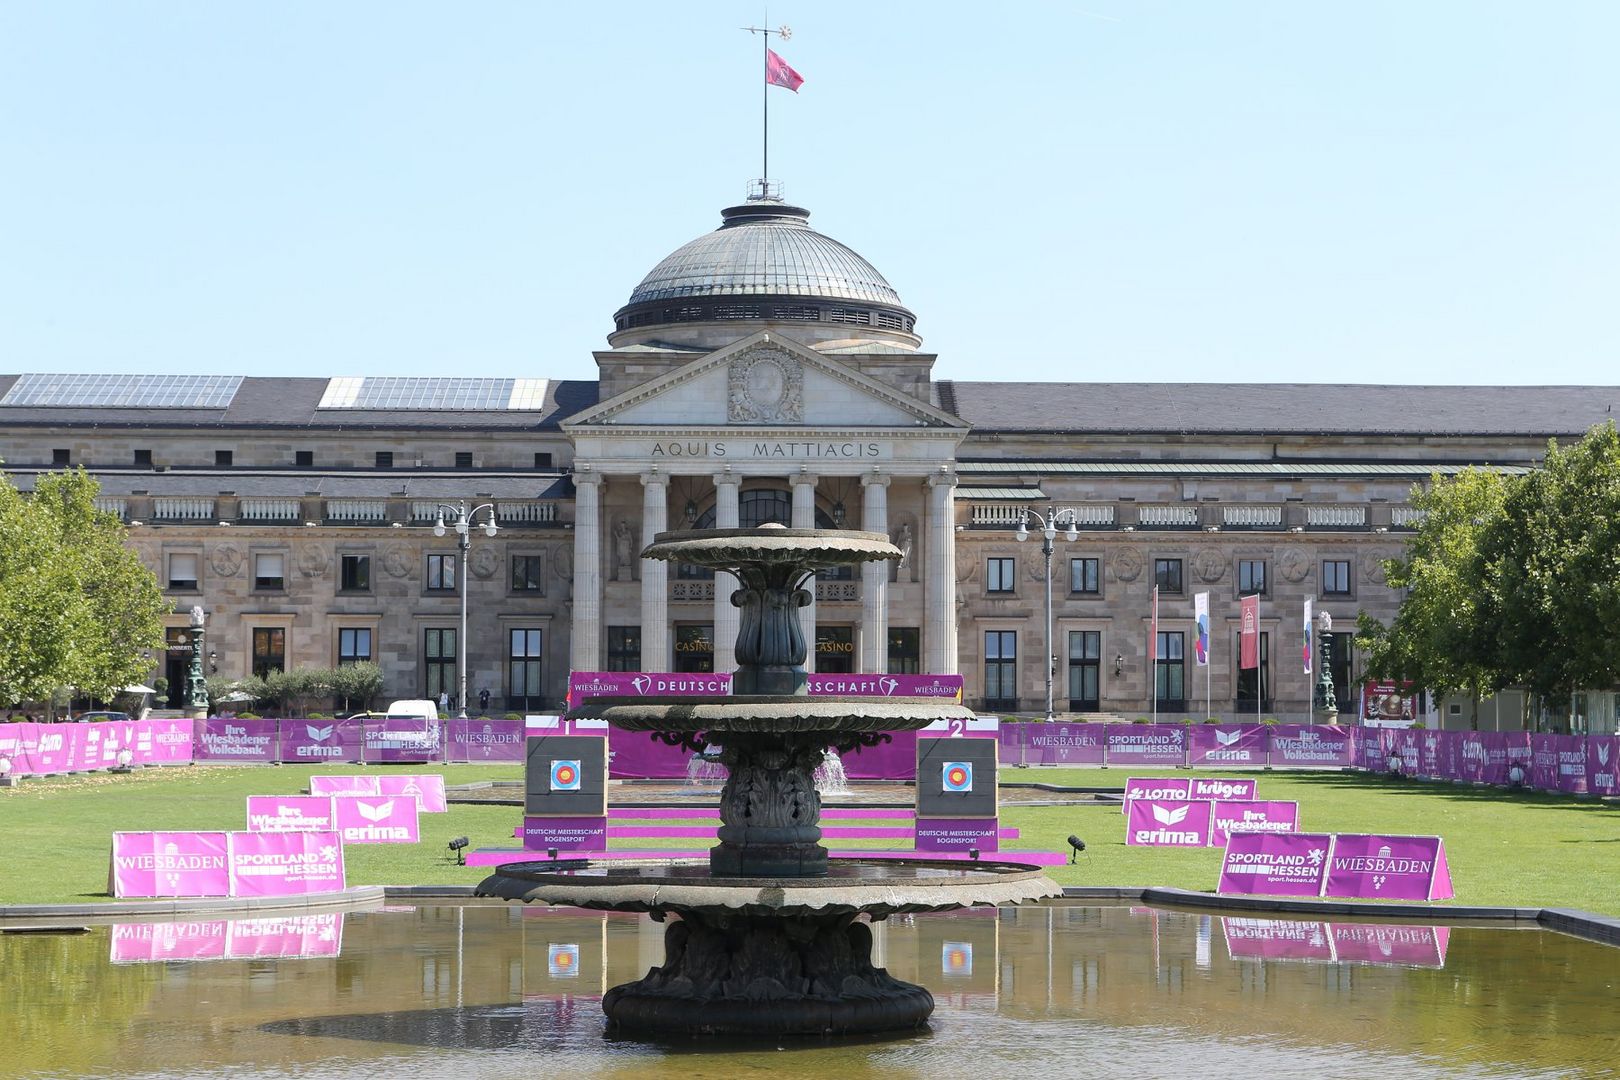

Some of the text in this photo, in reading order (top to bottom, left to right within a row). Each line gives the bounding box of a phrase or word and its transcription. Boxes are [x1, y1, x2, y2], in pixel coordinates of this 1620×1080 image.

[651, 442, 880, 457] AQUIS MATTIACIS
[574, 684, 619, 692] WIESBADEN
[658, 681, 876, 692] DEUTSCH RSCHAFT
[915, 686, 959, 694] WIESBADEN
[225, 724, 246, 735] Ihre
[951, 720, 964, 737] 2
[201, 733, 271, 745] Wiesbadener
[455, 734, 520, 744] WIESBADEN
[1032, 736, 1097, 746] WIESBADEN
[1109, 735, 1170, 744] SPORTLAND
[1300, 730, 1320, 741] Ihre
[208, 744, 266, 755] Volksbank.
[296, 744, 343, 756] erima
[401, 741, 440, 749] HESSEN
[1144, 745, 1182, 753] HESSEN
[1276, 739, 1344, 750] Wiesbadener
[1206, 748, 1250, 760] erima
[1284, 750, 1340, 760] Volksbank.
[1145, 788, 1186, 800] LOTTO
[1196, 781, 1248, 798] krüger
[251, 814, 328, 826] Wiesbadener
[1243, 810, 1266, 820] Ihre
[1216, 818, 1292, 831] Wiesbadener
[345, 824, 409, 840] erima
[1136, 828, 1199, 844] erima
[118, 855, 225, 870] WIESBADEN
[235, 853, 319, 865] SPORTLAND
[1227, 853, 1305, 865] SPORTLAND
[1335, 857, 1432, 873] WIESBADEN
[284, 863, 337, 875] HESSEN
[1269, 864, 1320, 877] HESSEN
[1267, 876, 1318, 884] sport.hessen.de
